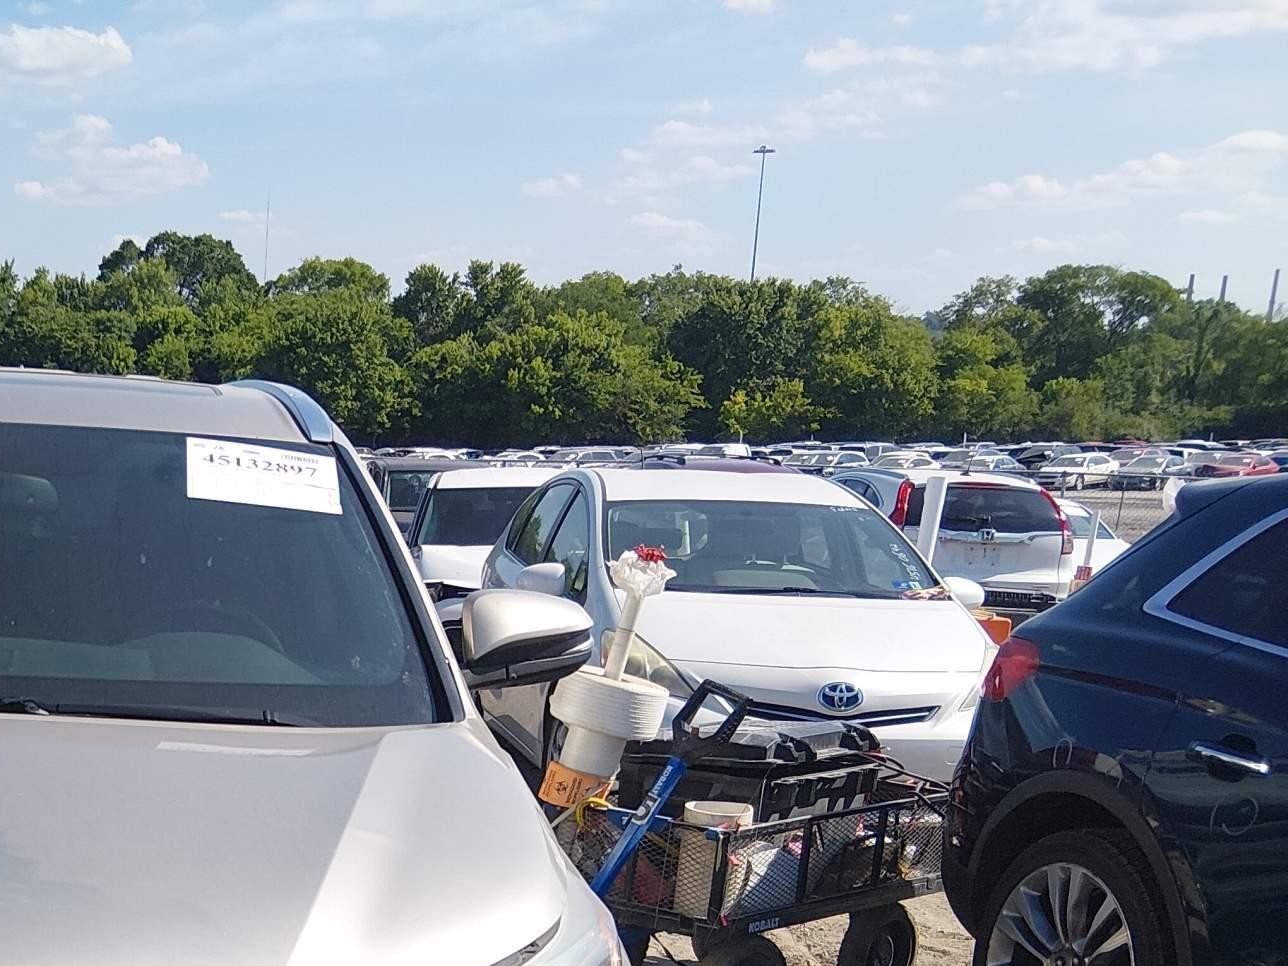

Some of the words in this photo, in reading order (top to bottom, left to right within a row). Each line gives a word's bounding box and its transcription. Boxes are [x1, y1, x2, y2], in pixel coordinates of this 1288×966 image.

[202, 453, 318, 477] 45132897
[652, 764, 674, 795] KOBALT
[748, 917, 781, 934] KOBALT
